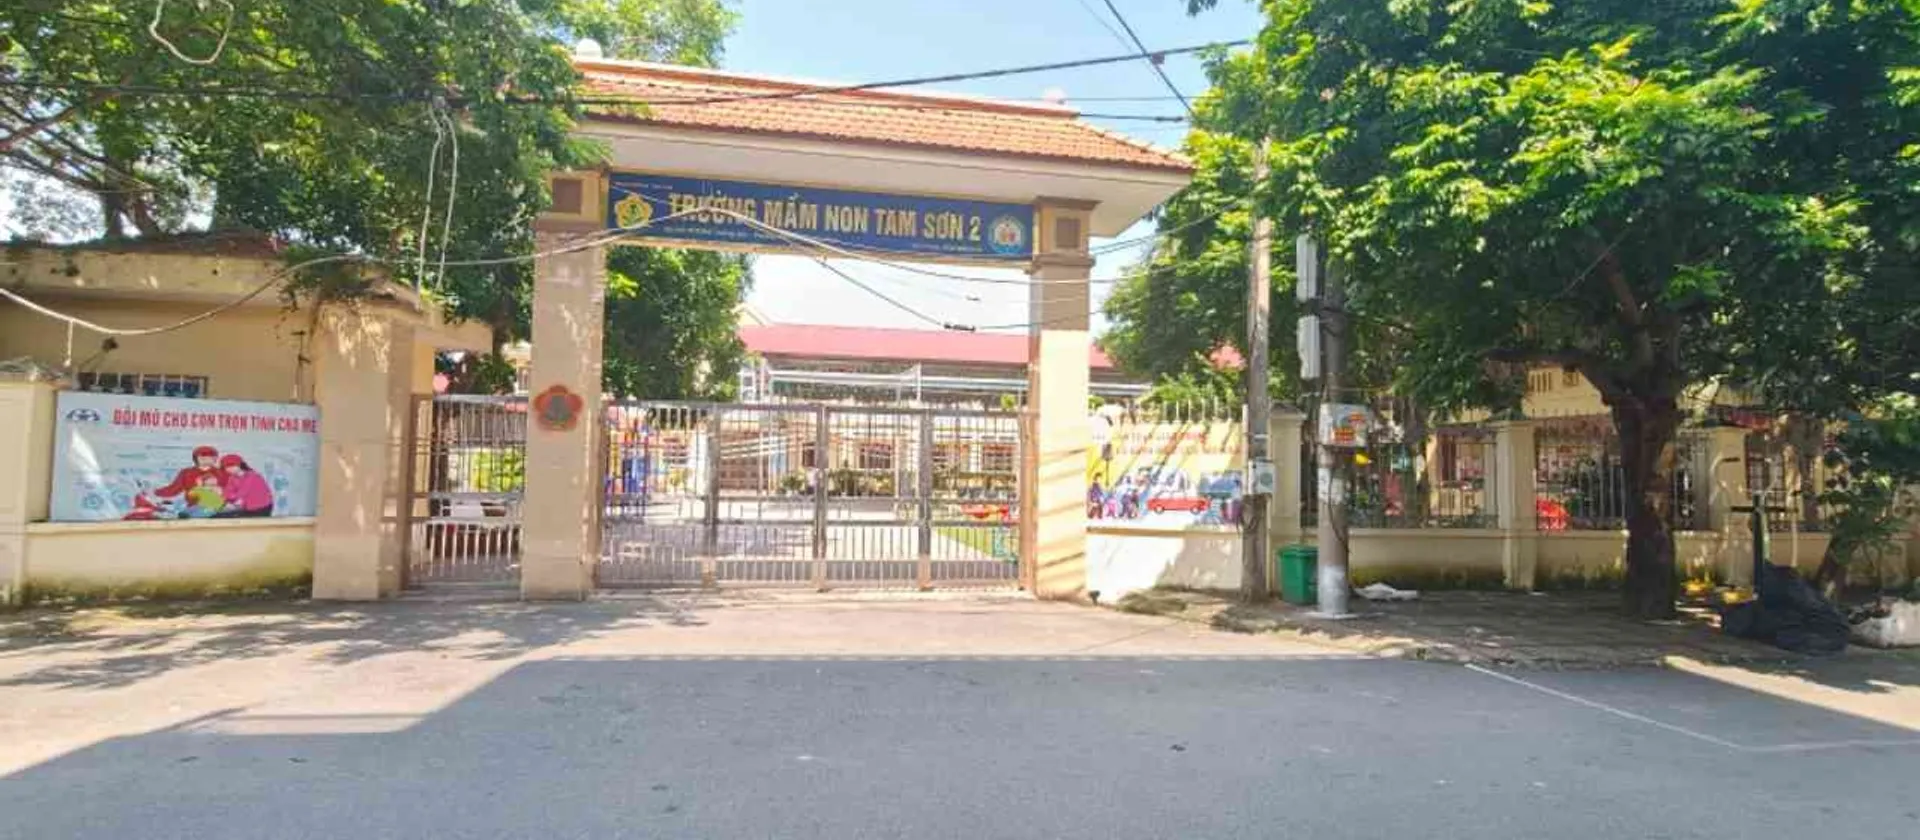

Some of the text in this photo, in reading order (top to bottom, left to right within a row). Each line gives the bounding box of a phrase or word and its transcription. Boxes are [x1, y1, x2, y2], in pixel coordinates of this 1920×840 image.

[668, 188, 757, 226] TRƯỜNG
[824, 204, 868, 233] NON
[874, 208, 917, 237] TAM
[923, 210, 964, 241] SƠN
[969, 216, 981, 241] 2
[162, 411, 188, 428] CHO
[191, 412, 216, 430] CON
